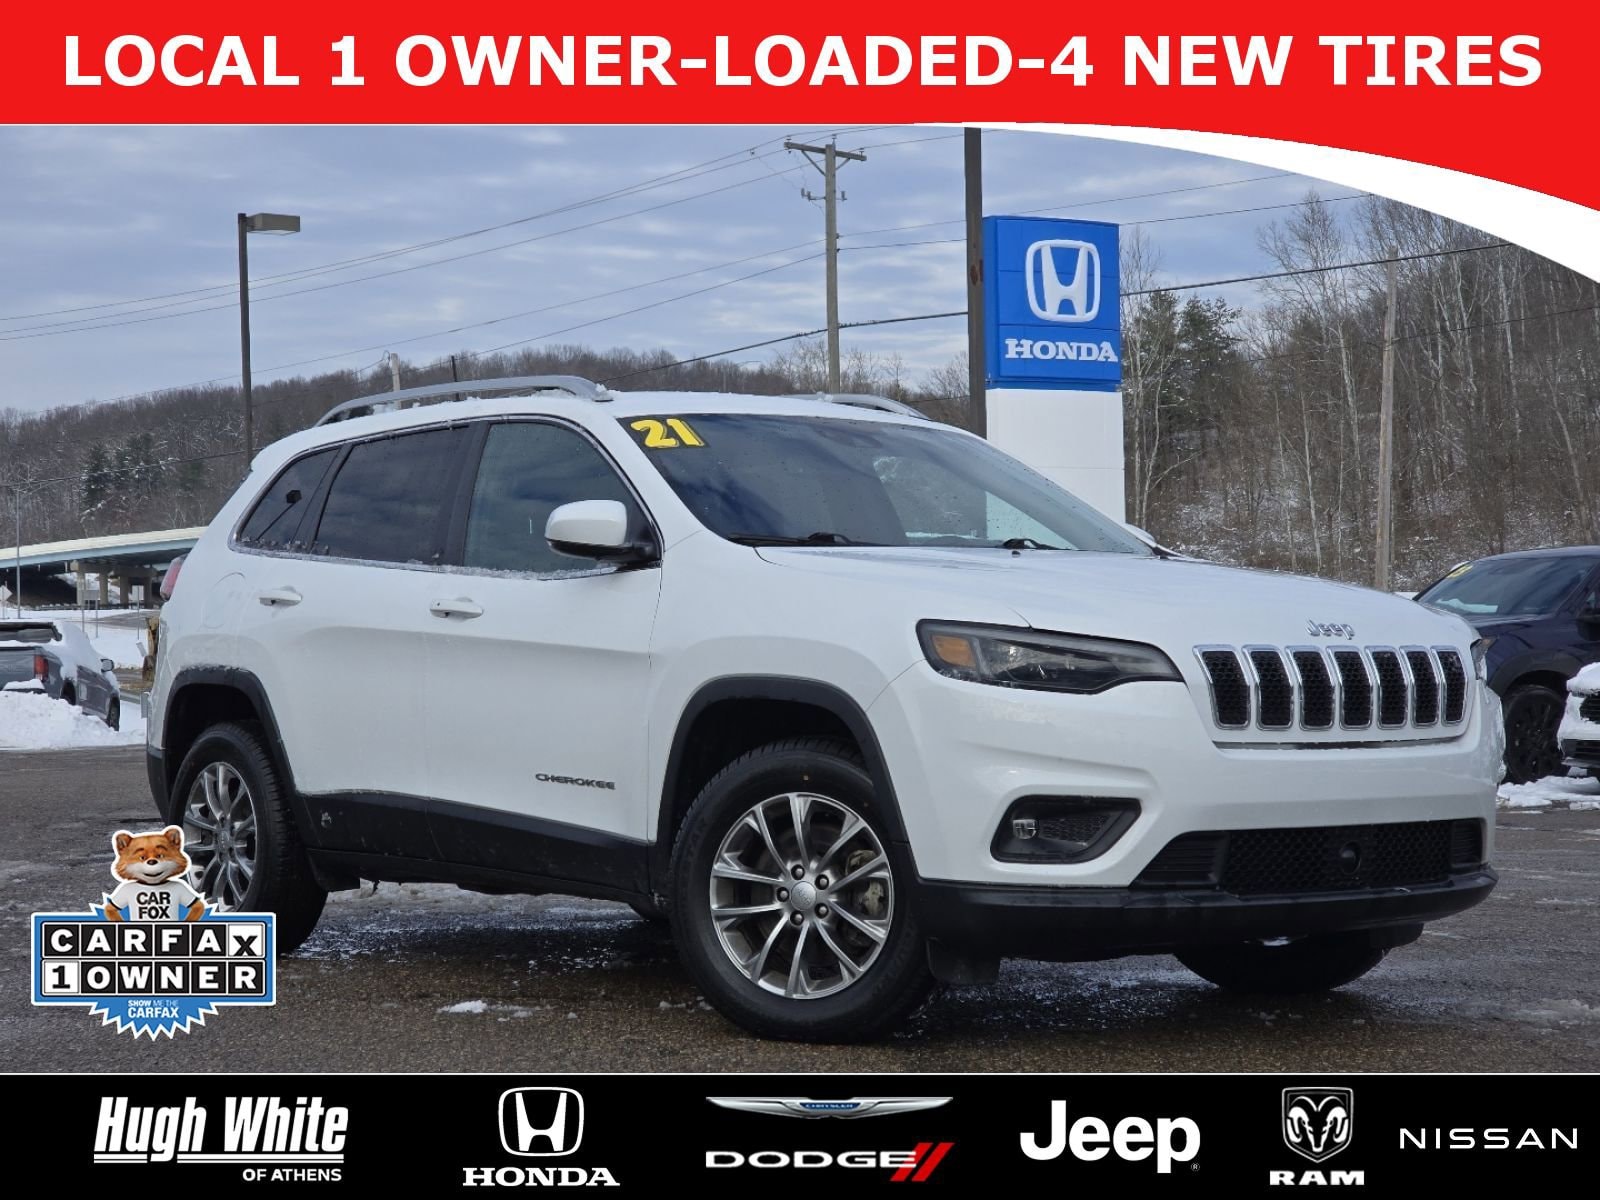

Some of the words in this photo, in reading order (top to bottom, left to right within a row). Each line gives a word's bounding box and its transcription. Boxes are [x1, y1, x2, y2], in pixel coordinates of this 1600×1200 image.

[1004, 338, 1119, 362] HONDA
[630, 418, 705, 448] 21
[1306, 620, 1355, 640] Jeep
[535, 772, 616, 790] CHEROKEE
